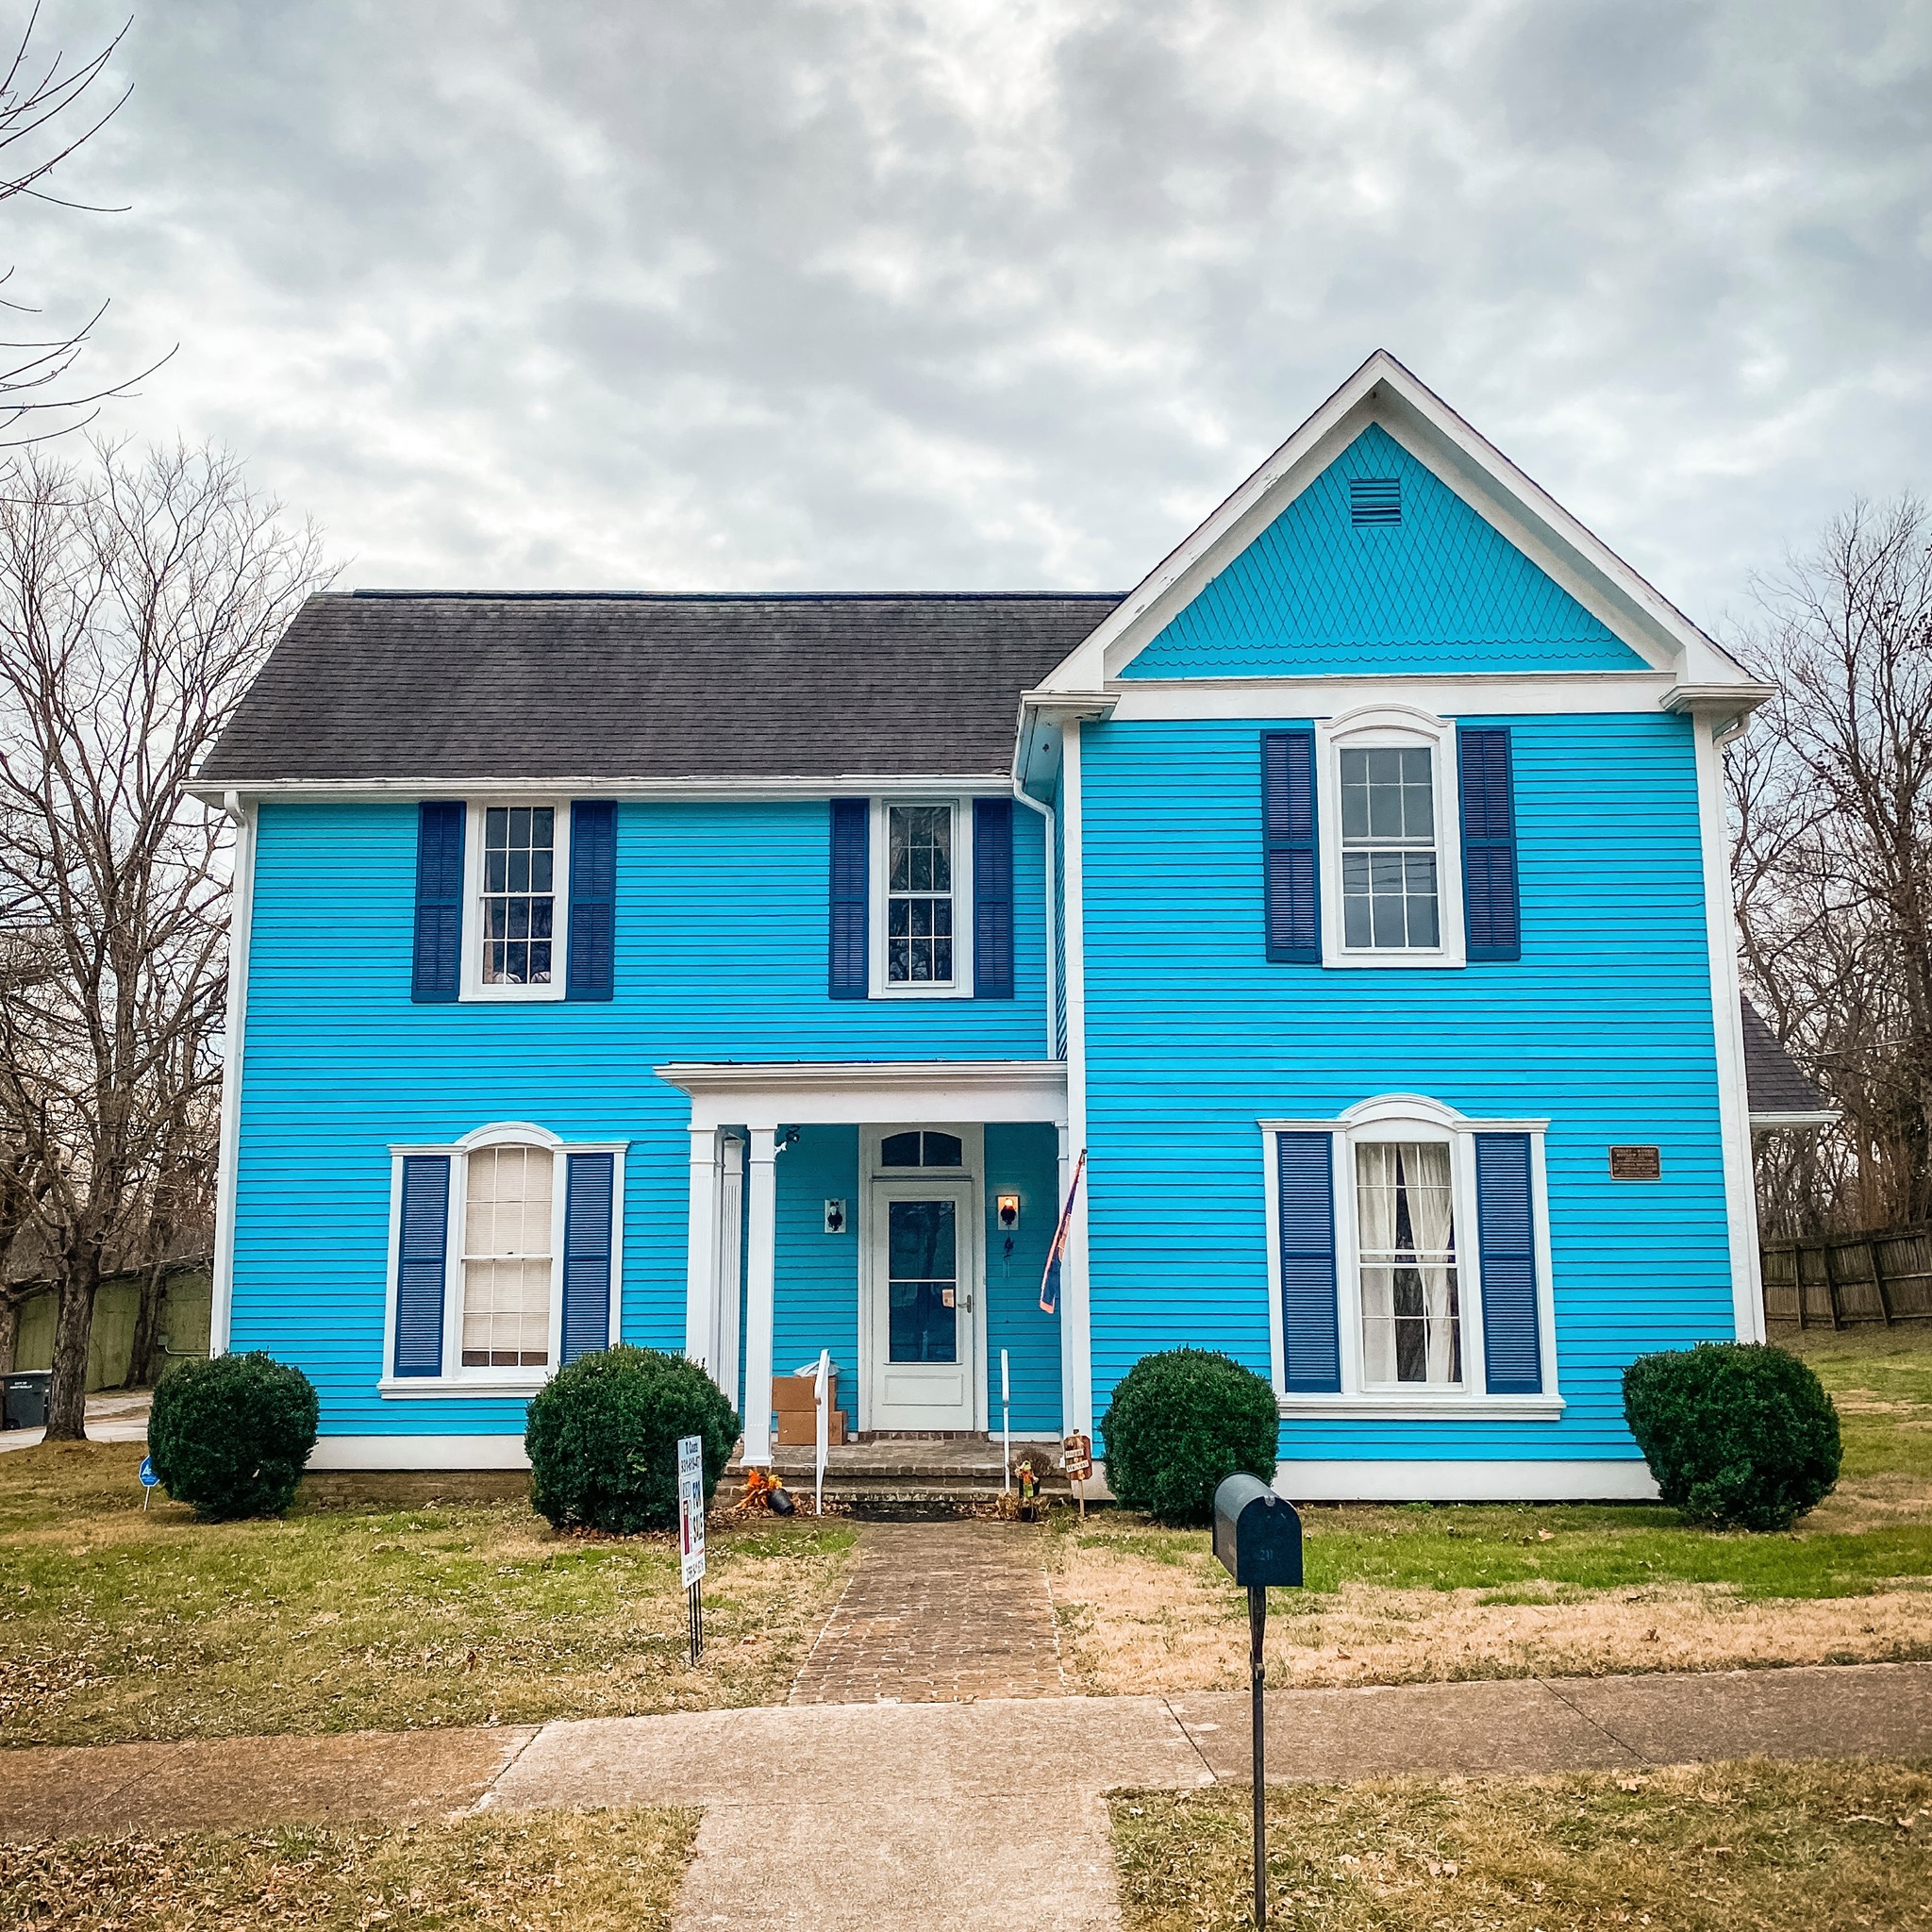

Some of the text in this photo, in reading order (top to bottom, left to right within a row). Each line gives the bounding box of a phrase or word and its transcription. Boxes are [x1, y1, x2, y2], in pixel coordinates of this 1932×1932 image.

[1067, 1462, 1089, 1471] Harvest
[692, 1480, 702, 1508] FOR
[692, 1511, 704, 1543] SALE
